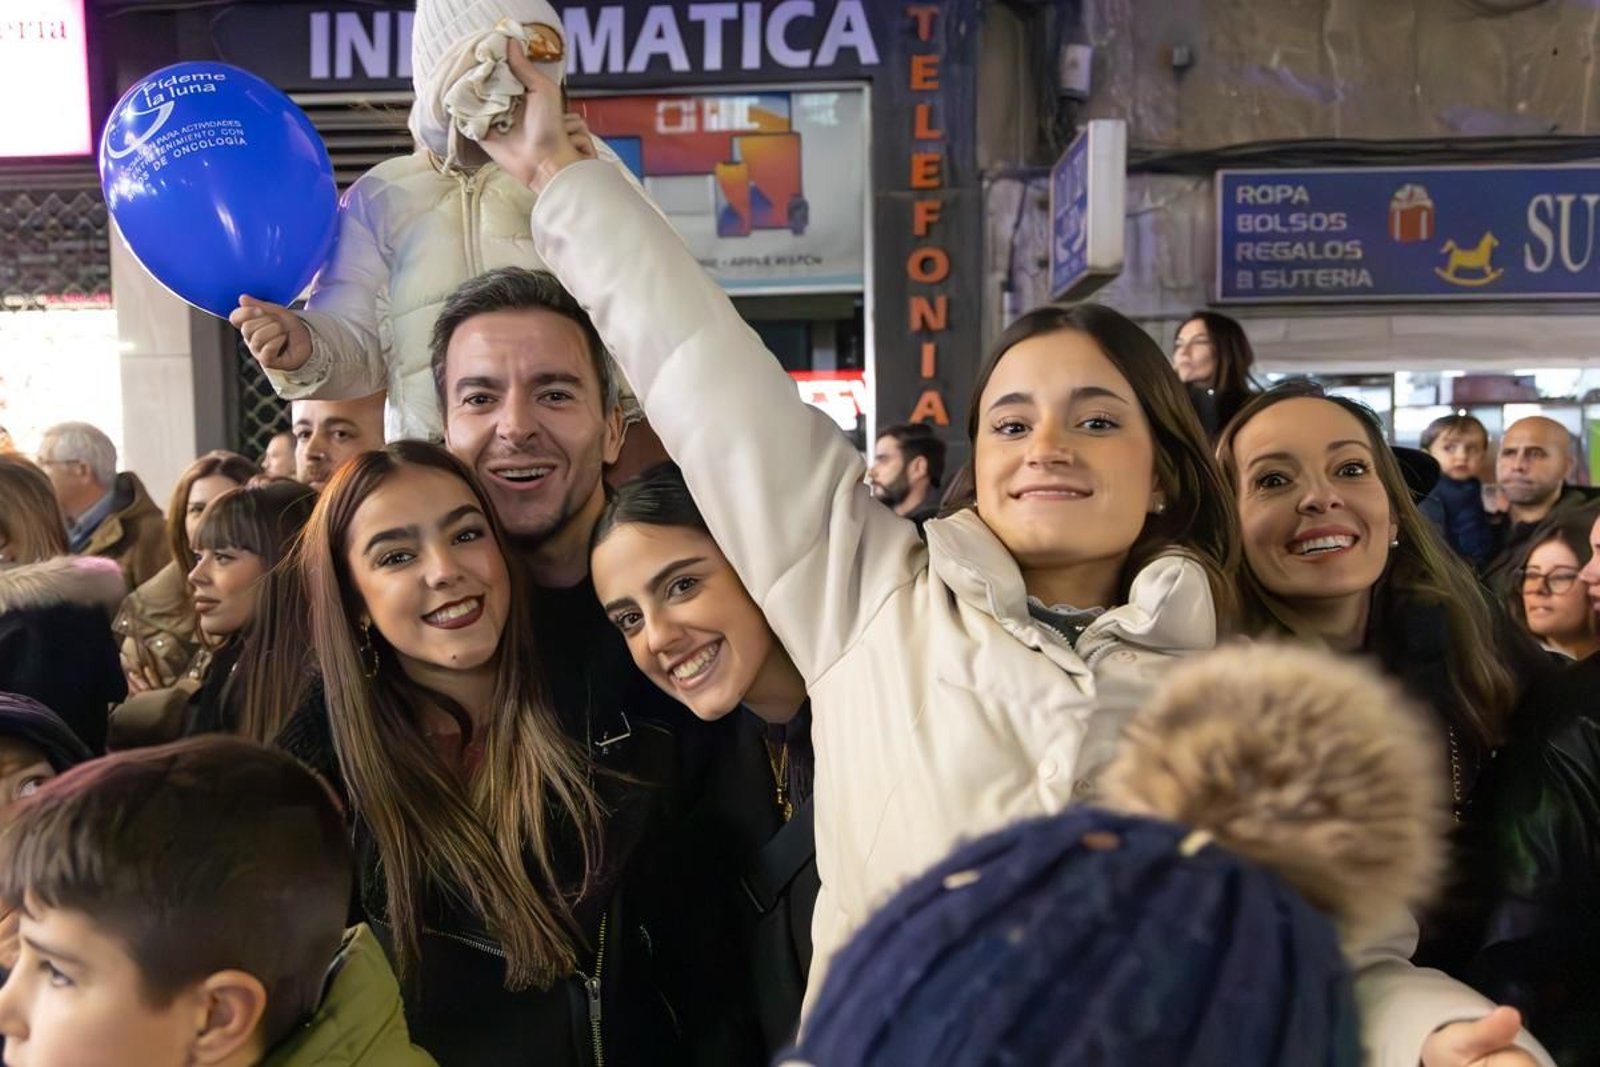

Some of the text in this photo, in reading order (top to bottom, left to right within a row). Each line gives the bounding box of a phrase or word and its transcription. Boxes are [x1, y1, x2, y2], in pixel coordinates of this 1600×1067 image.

[310, 0, 880, 79] INMATICA
[145, 83, 217, 108] la luna
[156, 129, 181, 145] PARA
[181, 120, 242, 134] ACTIVIDADES
[220, 127, 245, 137] CON
[153, 136, 248, 172] DE ONCOLOGÍA
[1236, 184, 1311, 205] ROPA
[905, 6, 950, 426] TELEFONIA
[1236, 212, 1348, 233] BOLSOS
[1236, 240, 1363, 262] REGALOS
